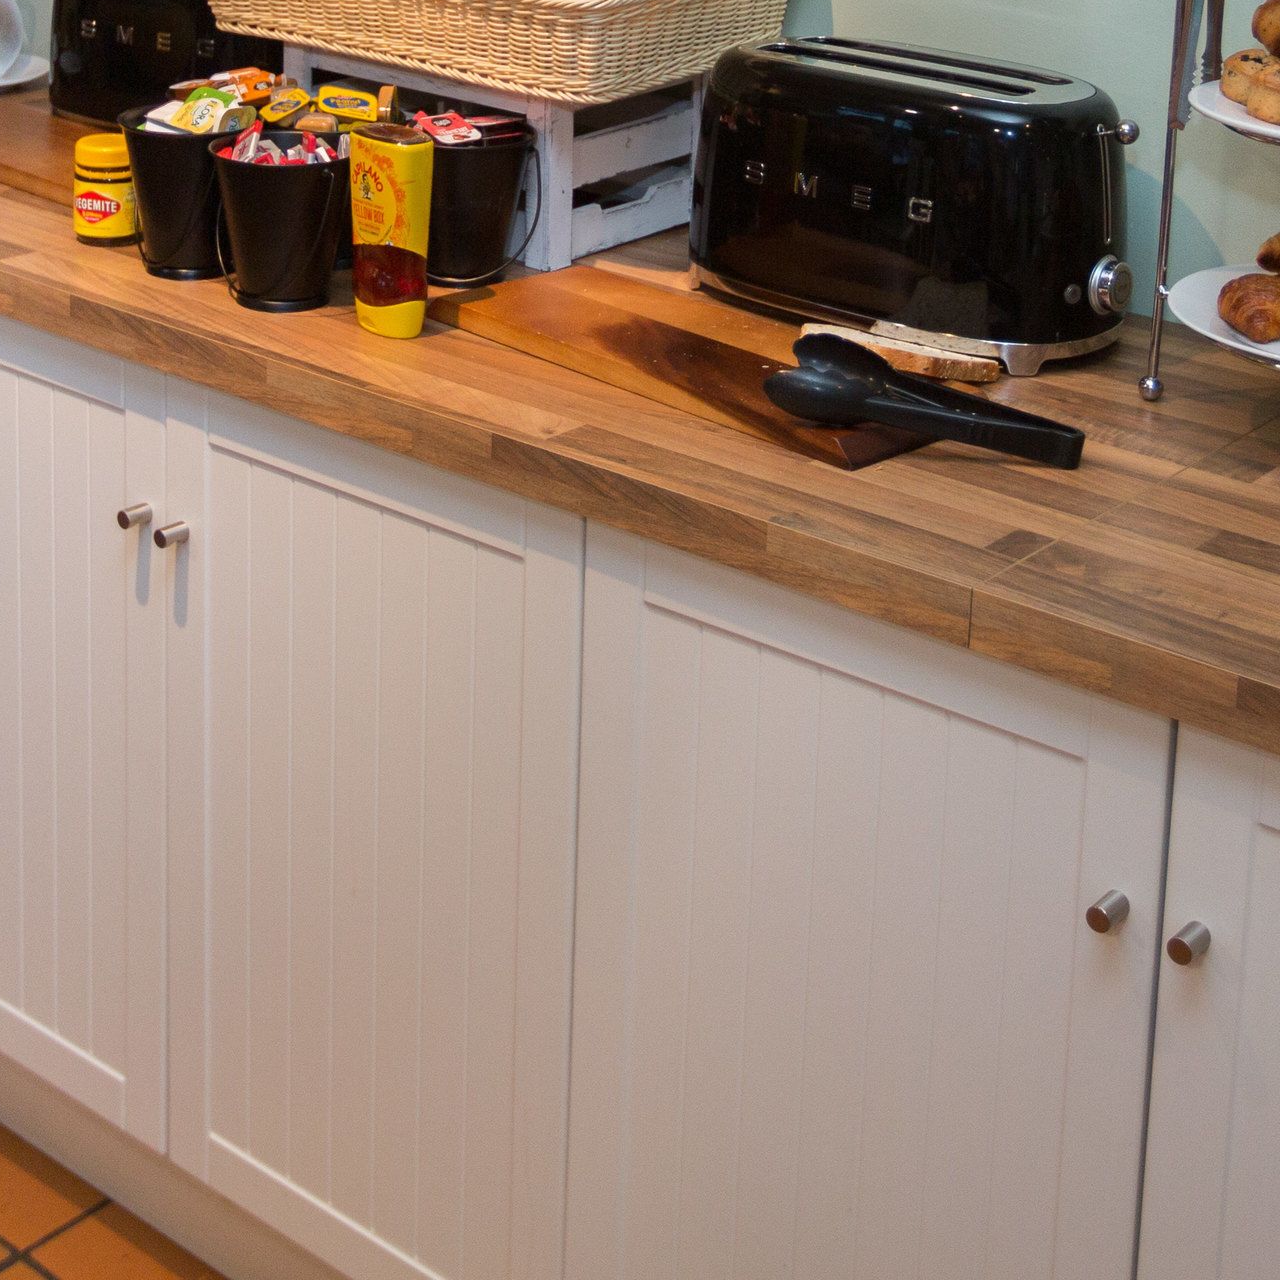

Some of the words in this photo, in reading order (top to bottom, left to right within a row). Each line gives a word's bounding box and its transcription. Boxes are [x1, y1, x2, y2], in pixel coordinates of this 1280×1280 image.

[81, 20, 215, 58] SMEG
[352, 162, 384, 192] CAPILANO
[745, 160, 933, 223] SMEG
